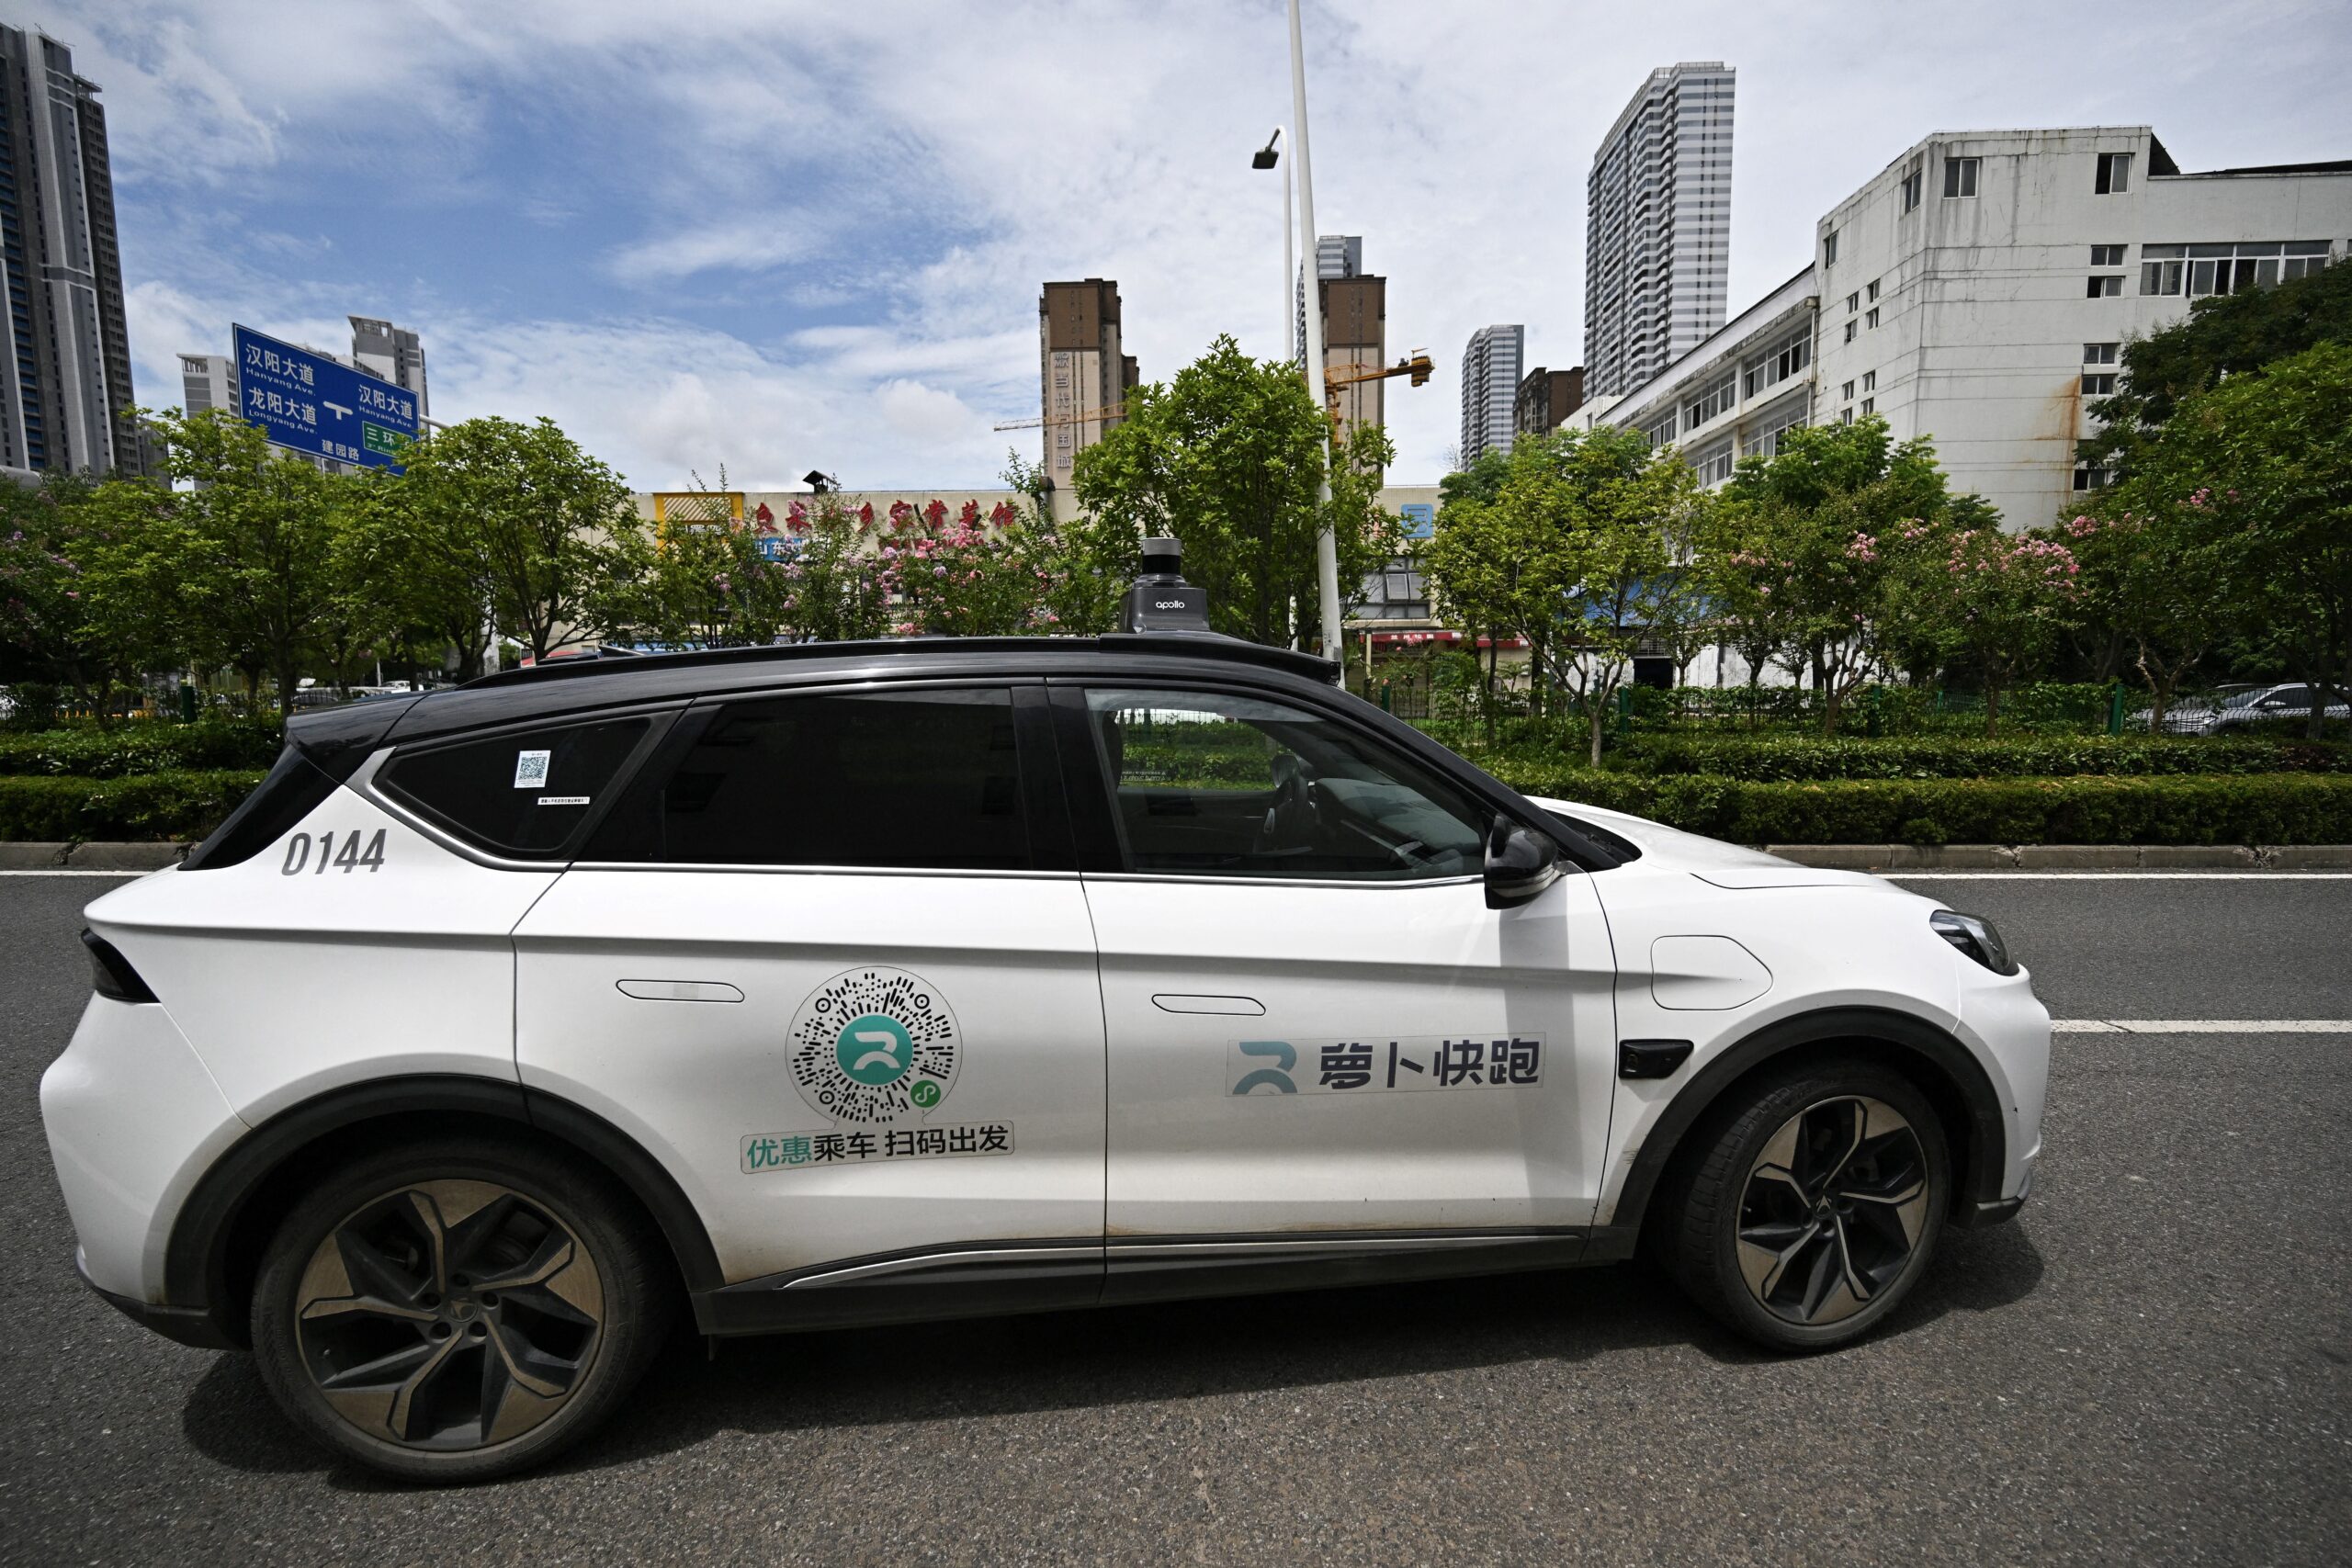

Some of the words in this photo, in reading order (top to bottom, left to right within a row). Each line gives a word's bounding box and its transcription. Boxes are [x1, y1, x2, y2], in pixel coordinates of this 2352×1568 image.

[245, 343, 314, 386] 汉阳大道
[246, 367, 291, 389] Hanyang
[295, 384, 316, 396] Ave.
[248, 387, 317, 425] 龙阳大道
[358, 384, 413, 420] 汉阳大道
[358, 405, 395, 423] Hanyang
[249, 409, 295, 429] Longyang
[297, 423, 318, 434] Ave.
[367, 426, 410, 447] 三环
[322, 439, 359, 461] 建园路
[752, 499, 1017, 534] 鱼米乡家常菜馆
[1156, 600, 1185, 610] apollo
[281, 829, 387, 875] 0144
[1318, 1038, 1540, 1089] 萝卜快跑
[746, 1131, 877, 1169] 优惠乘车
[885, 1124, 1010, 1157] 扫码出发
